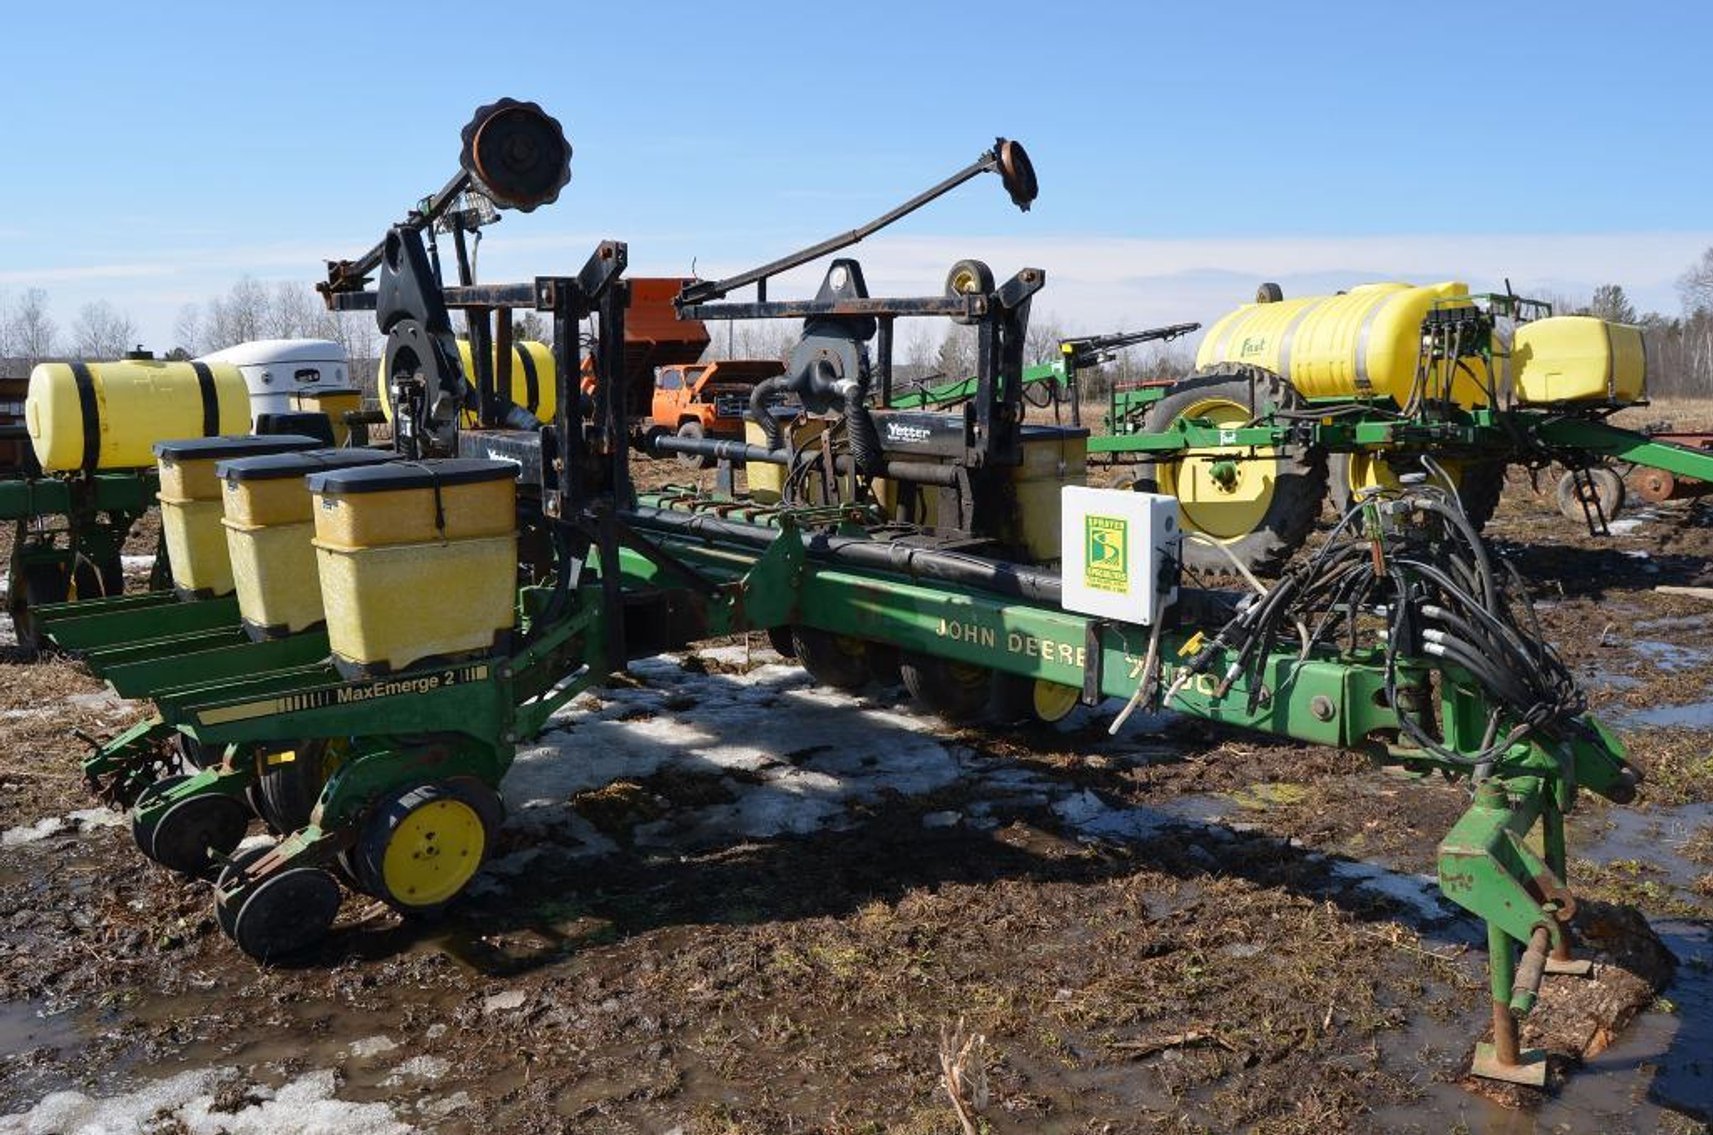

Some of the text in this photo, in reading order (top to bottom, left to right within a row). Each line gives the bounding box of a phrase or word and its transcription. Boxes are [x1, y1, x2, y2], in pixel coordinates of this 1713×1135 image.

[1240, 337, 1265, 358] Fast
[887, 422, 930, 438] Yetter
[935, 619, 1086, 667] JOHN DEERE
[337, 671, 455, 703] MaxEmerge 2
